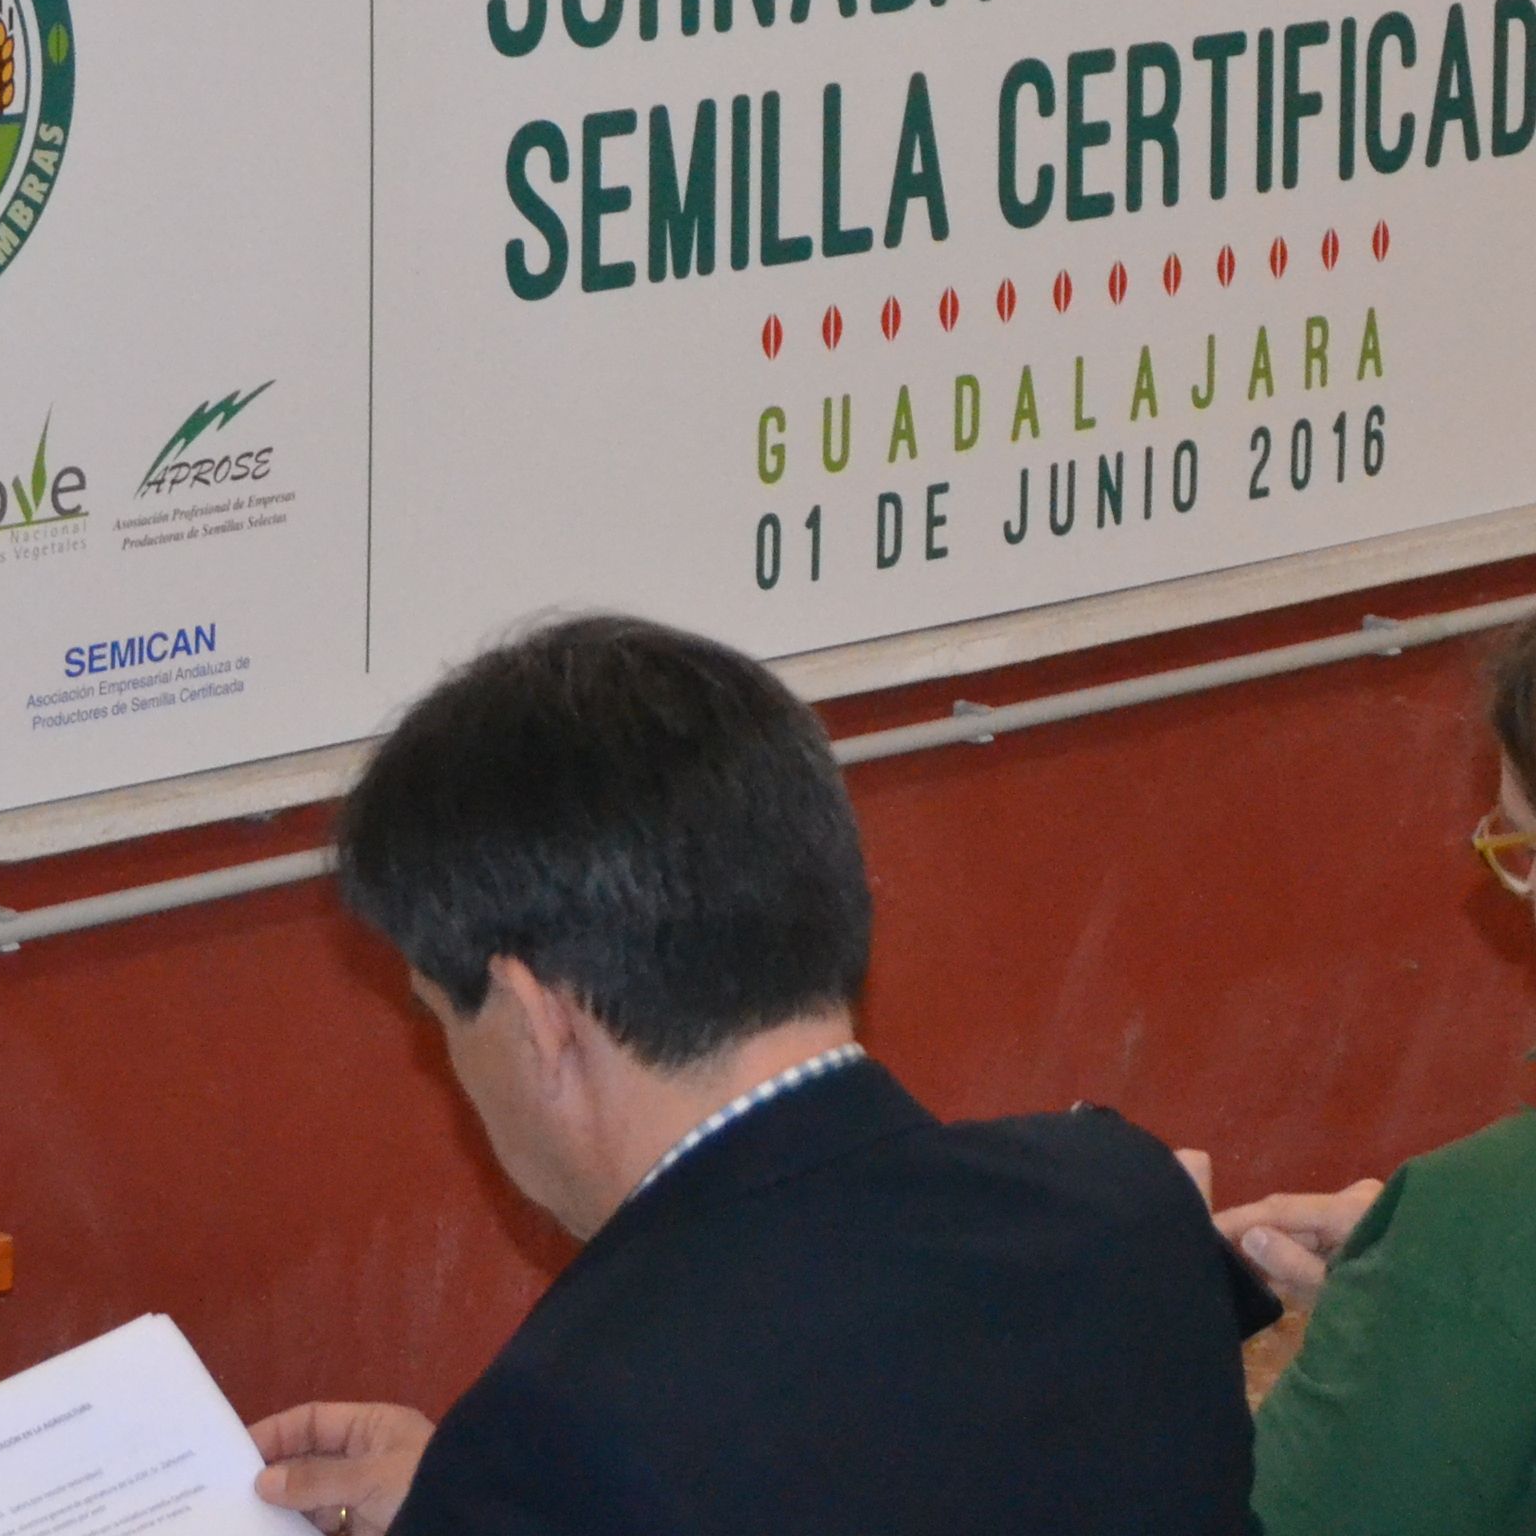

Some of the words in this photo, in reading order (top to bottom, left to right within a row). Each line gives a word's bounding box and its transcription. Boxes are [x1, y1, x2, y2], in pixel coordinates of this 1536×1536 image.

[503, 71, 950, 302] SEMILLA
[756, 306, 1384, 486] GUADALAJARA
[140, 447, 273, 498] APROSE
[755, 503, 822, 591] 01
[877, 482, 950, 571] DE
[1003, 439, 1199, 546] JUNIO
[1248, 404, 1386, 499] 2016
[232, 496, 245, 511] de
[247, 490, 296, 509] Empresas
[10, 519, 87, 544] Nacional
[14, 537, 87, 561] Vegetales
[186, 525, 200, 540] de
[202, 519, 244, 536] Semillas
[64, 623, 216, 678] SEMICAN
[26, 685, 95, 710] Asociación
[99, 669, 173, 696] Empresarial
[175, 660, 232, 681] Andaluza
[235, 654, 251, 670] de
[32, 704, 109, 731] Productores
[111, 701, 128, 717] de
[131, 693, 176, 713] Semilla
[180, 678, 244, 703] Certificada
